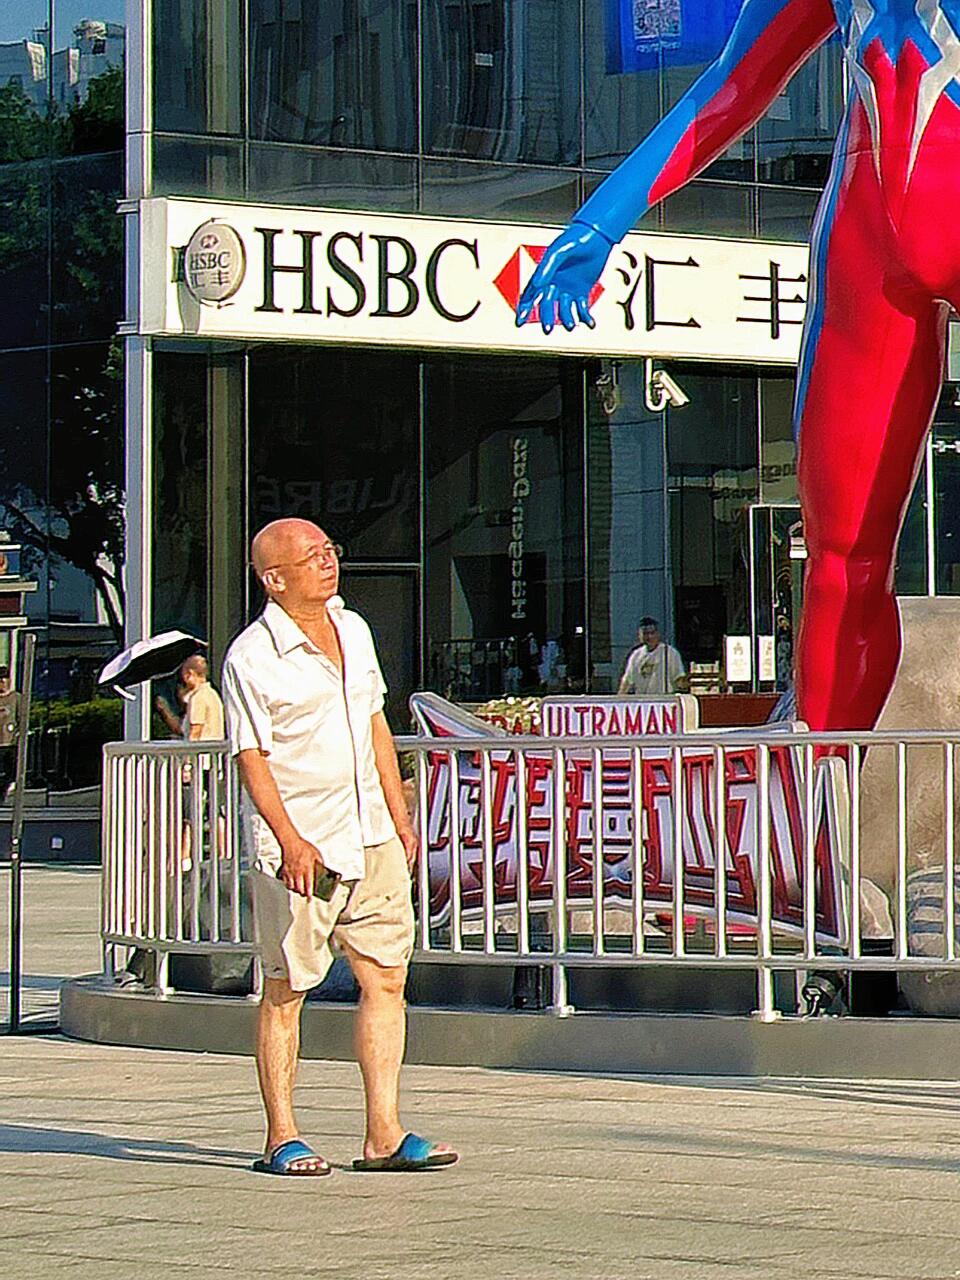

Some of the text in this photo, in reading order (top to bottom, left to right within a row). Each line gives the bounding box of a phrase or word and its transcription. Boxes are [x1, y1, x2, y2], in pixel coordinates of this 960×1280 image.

[189, 250, 231, 270] HSBC
[253, 227, 481, 323] HSBC
[615, 250, 807, 340] 汇丰
[547, 704, 680, 736] ULTRAMAN
